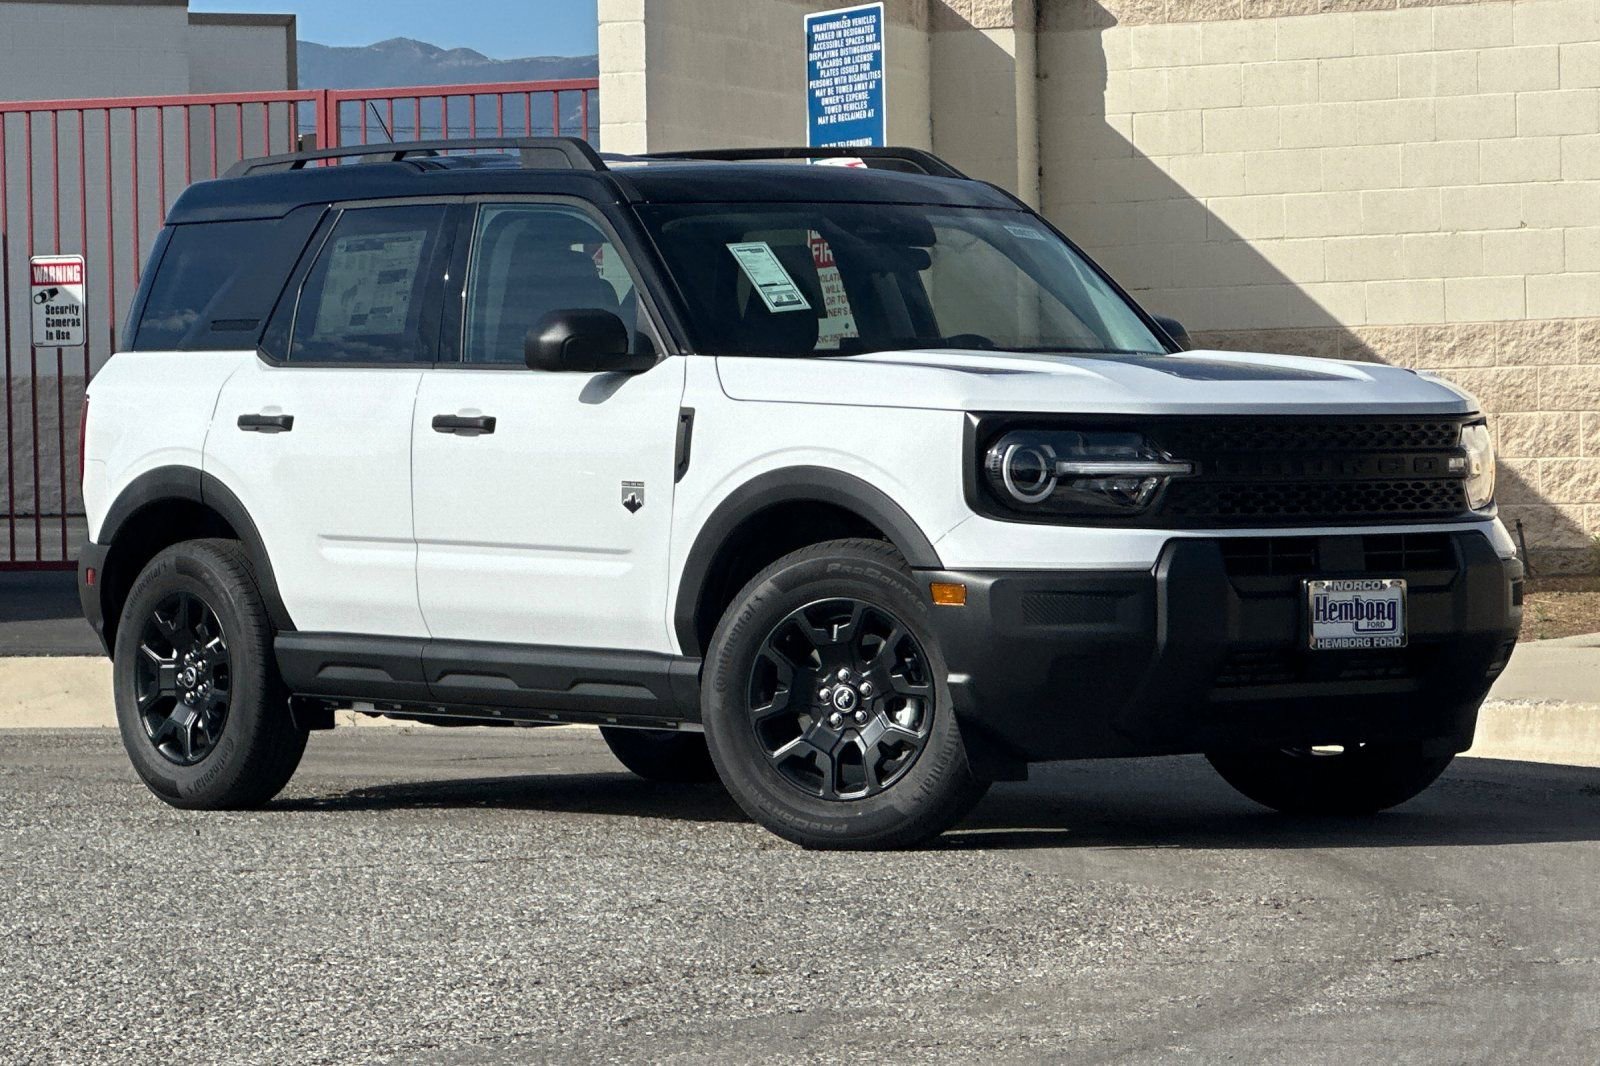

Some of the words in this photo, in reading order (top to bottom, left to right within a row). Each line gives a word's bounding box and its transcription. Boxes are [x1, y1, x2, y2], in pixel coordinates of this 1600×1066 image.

[813, 19, 851, 32] UNAUTHORIZED
[852, 15, 876, 26] VEHICLES
[815, 30, 835, 41] PARKED
[836, 30, 842, 38] IN
[843, 25, 874, 37] DESIGNATED
[813, 39, 844, 51] ACCESSIBLE
[846, 36, 864, 46] SPACES
[866, 34, 876, 42] NOT
[809, 48, 838, 61] DISPLAYING
[840, 43, 880, 56] DISTINGUISHING
[817, 57, 842, 69] PLACARDS
[844, 56, 851, 64] OR
[852, 53, 873, 63] LICENSE
[820, 68, 839, 78] PLATES
[840, 65, 858, 74] ISSUED
[860, 63, 870, 71] FOR
[810, 79, 833, 89] PERSONS
[834, 77, 847, 85] WITH
[848, 70, 881, 83] DISABILITIES
[816, 89, 827, 97] MAY
[836, 84, 852, 94] TOWED
[854, 82, 868, 91] AWAY
[869, 81, 876, 89] AT
[821, 95, 844, 106] OWNER'S
[846, 91, 870, 102] EXPENSE.
[824, 104, 842, 114] TOWED
[843, 101, 867, 112] VEHICLES
[818, 116, 829, 125] MAY
[830, 115, 836, 123] BE
[838, 111, 866, 122] RECLAIMED
[868, 109, 874, 117] AT
[34, 265, 80, 283] WARNING
[45, 304, 79, 316] Security
[46, 318, 80, 327] Cameras
[46, 330, 53, 340] In
[56, 330, 70, 340] Use
[1334, 581, 1381, 591] NORCO
[1315, 596, 1397, 631] Hemborg
[1318, 639, 1370, 648] HEMBORG
[1374, 638, 1401, 647] FORD
